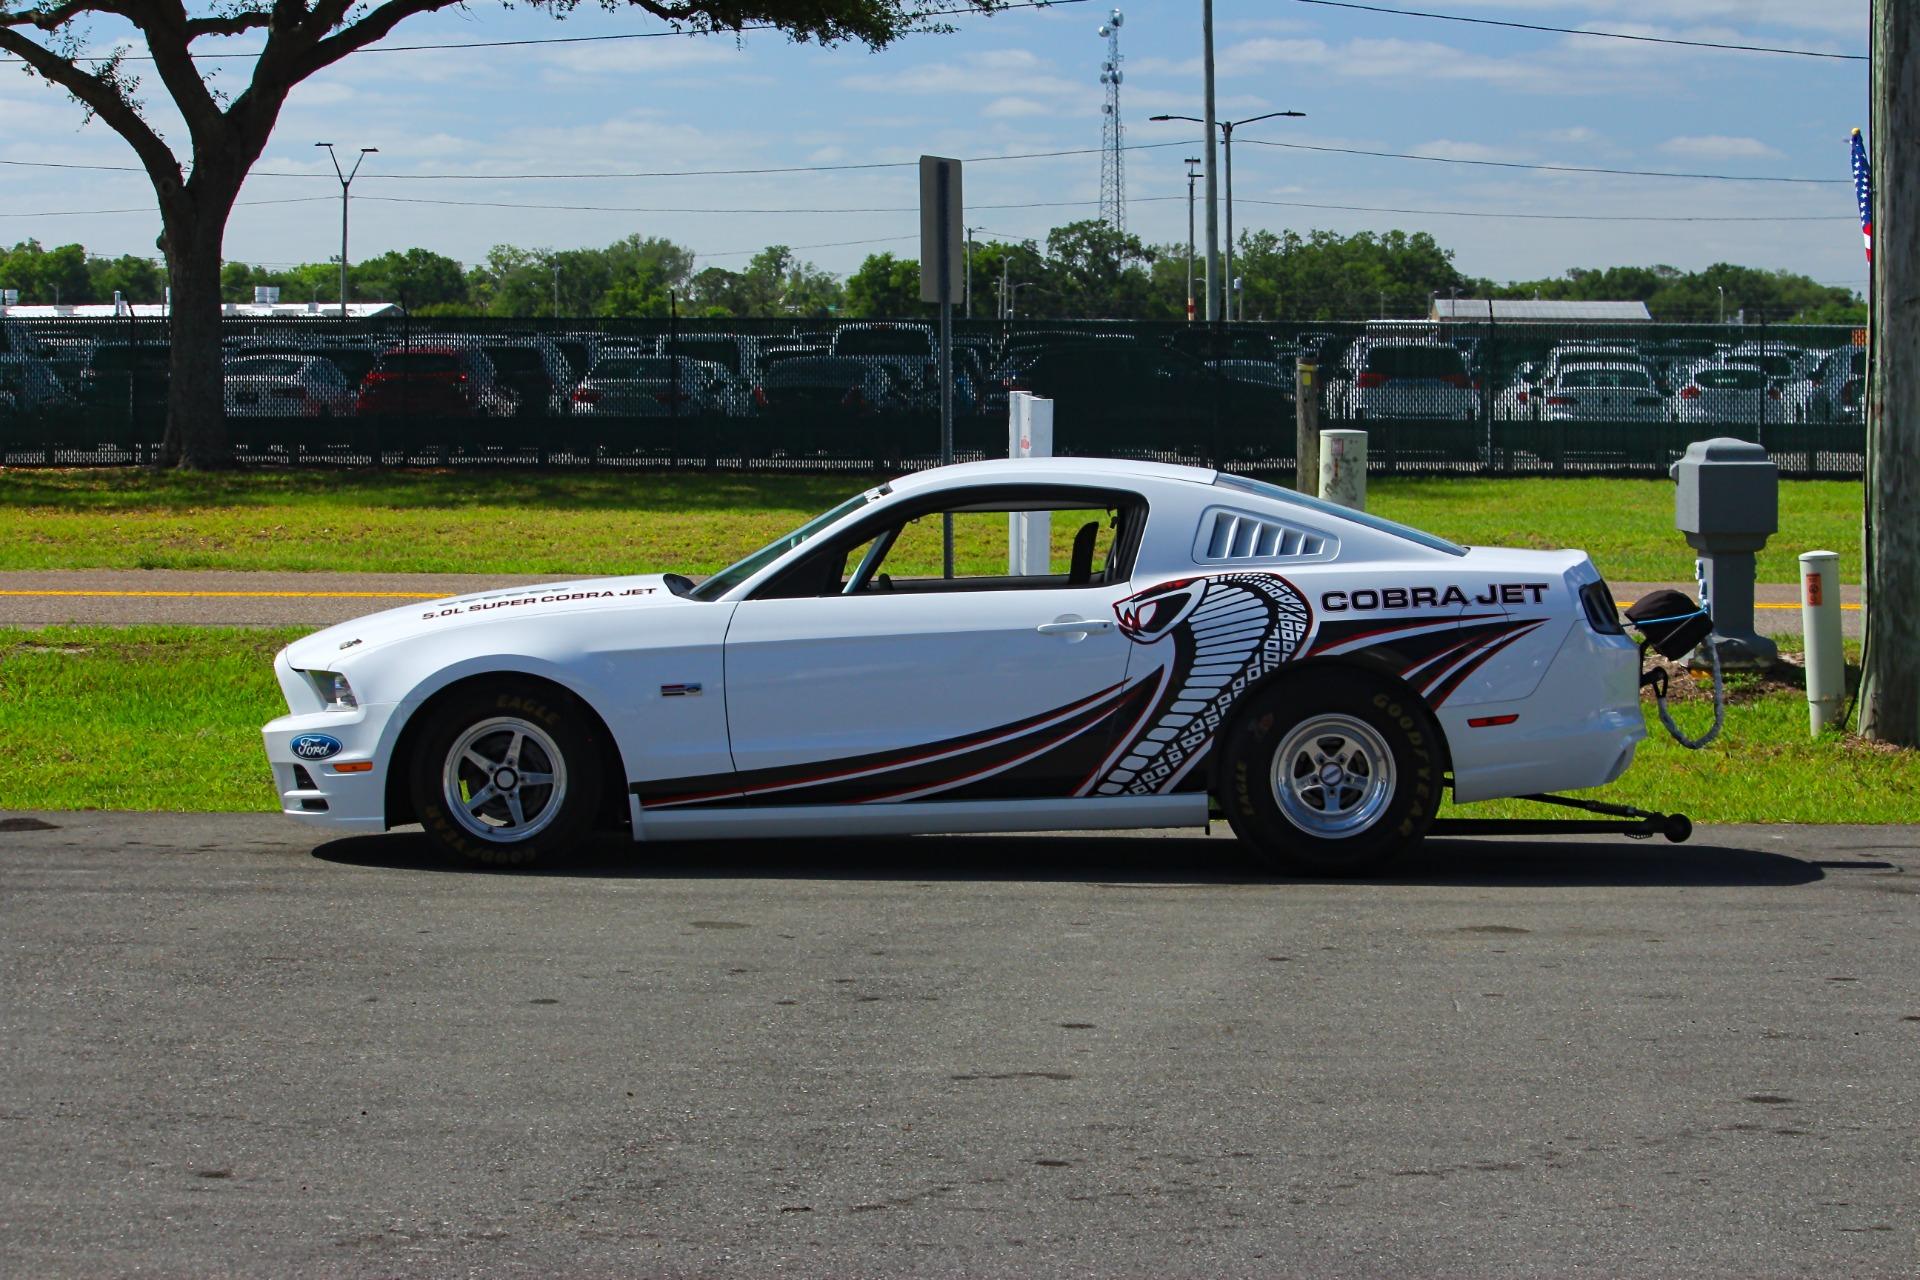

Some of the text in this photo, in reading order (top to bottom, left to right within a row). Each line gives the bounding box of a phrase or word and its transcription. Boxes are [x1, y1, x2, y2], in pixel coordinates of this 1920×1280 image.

[422, 587, 658, 620] 5.0L SUPER COBRA JET
[1320, 583, 1550, 612] COBRA JET
[298, 737, 331, 756] Ford
